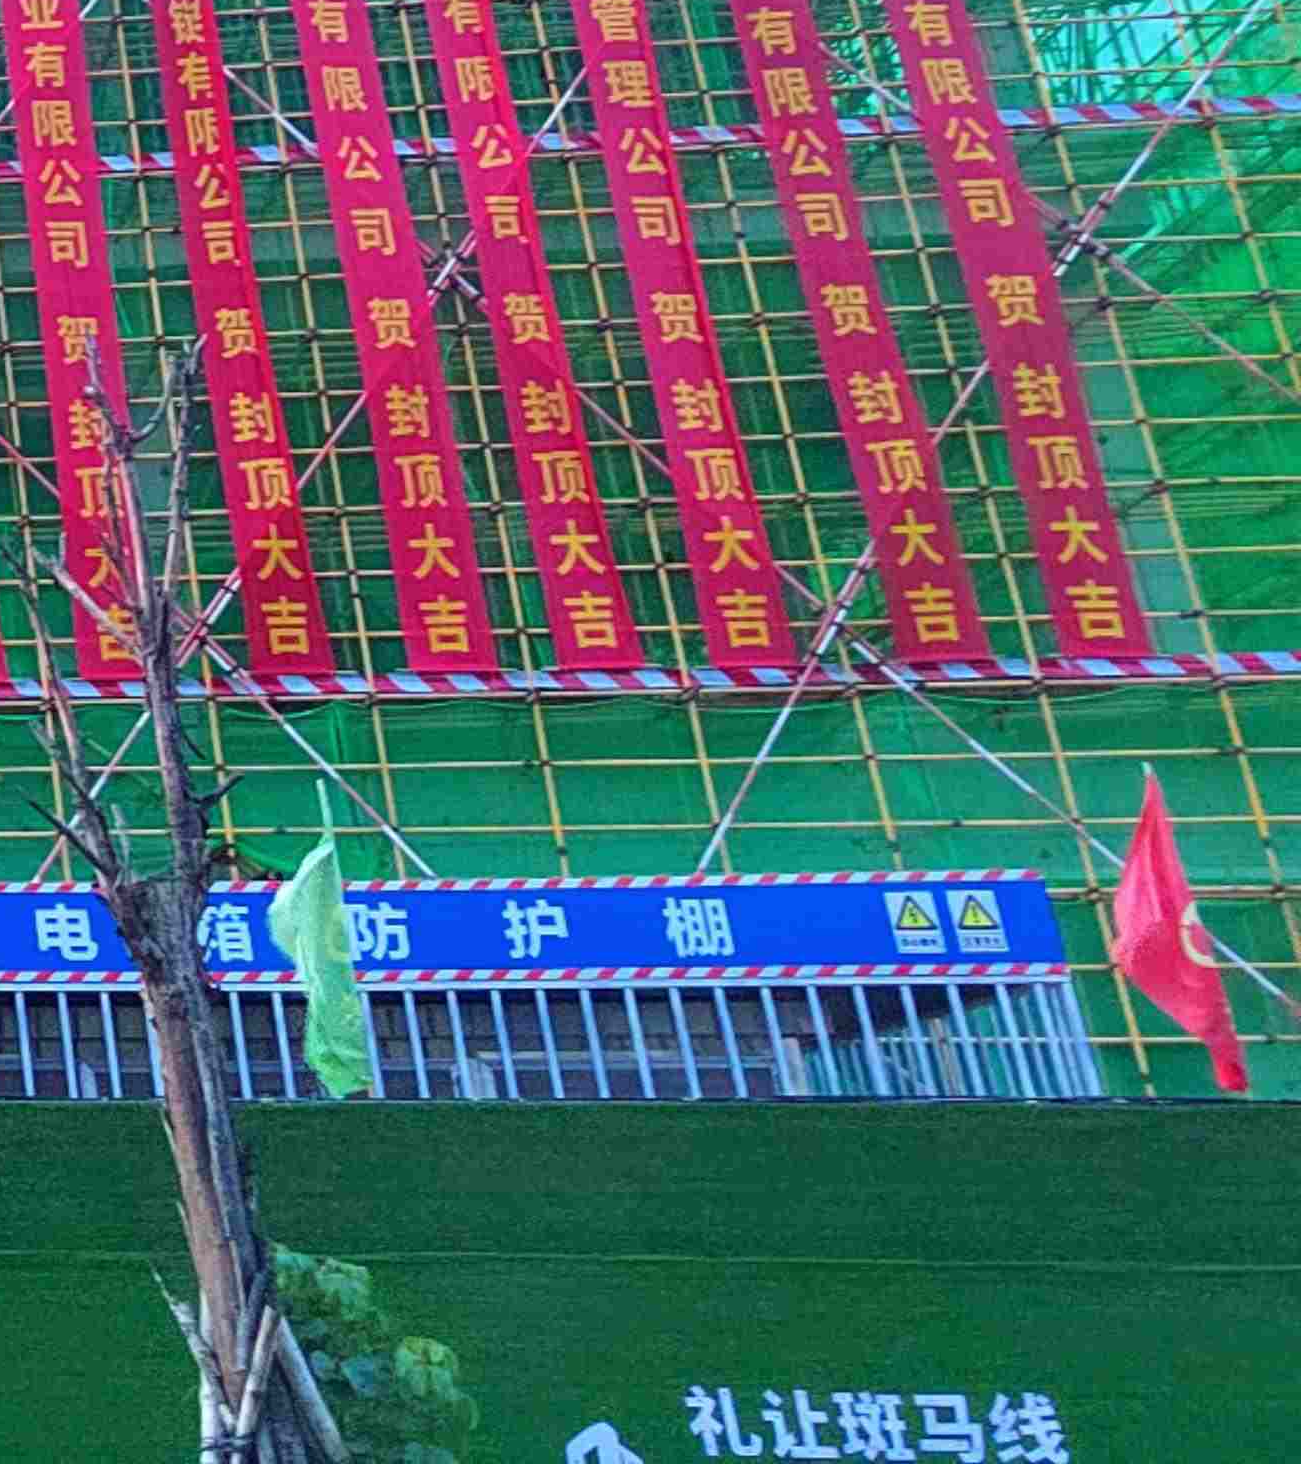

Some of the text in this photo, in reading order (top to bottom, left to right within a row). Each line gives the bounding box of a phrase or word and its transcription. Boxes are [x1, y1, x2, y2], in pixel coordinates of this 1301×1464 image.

[683, 1383, 1070, 1464] 礼让斑马线
